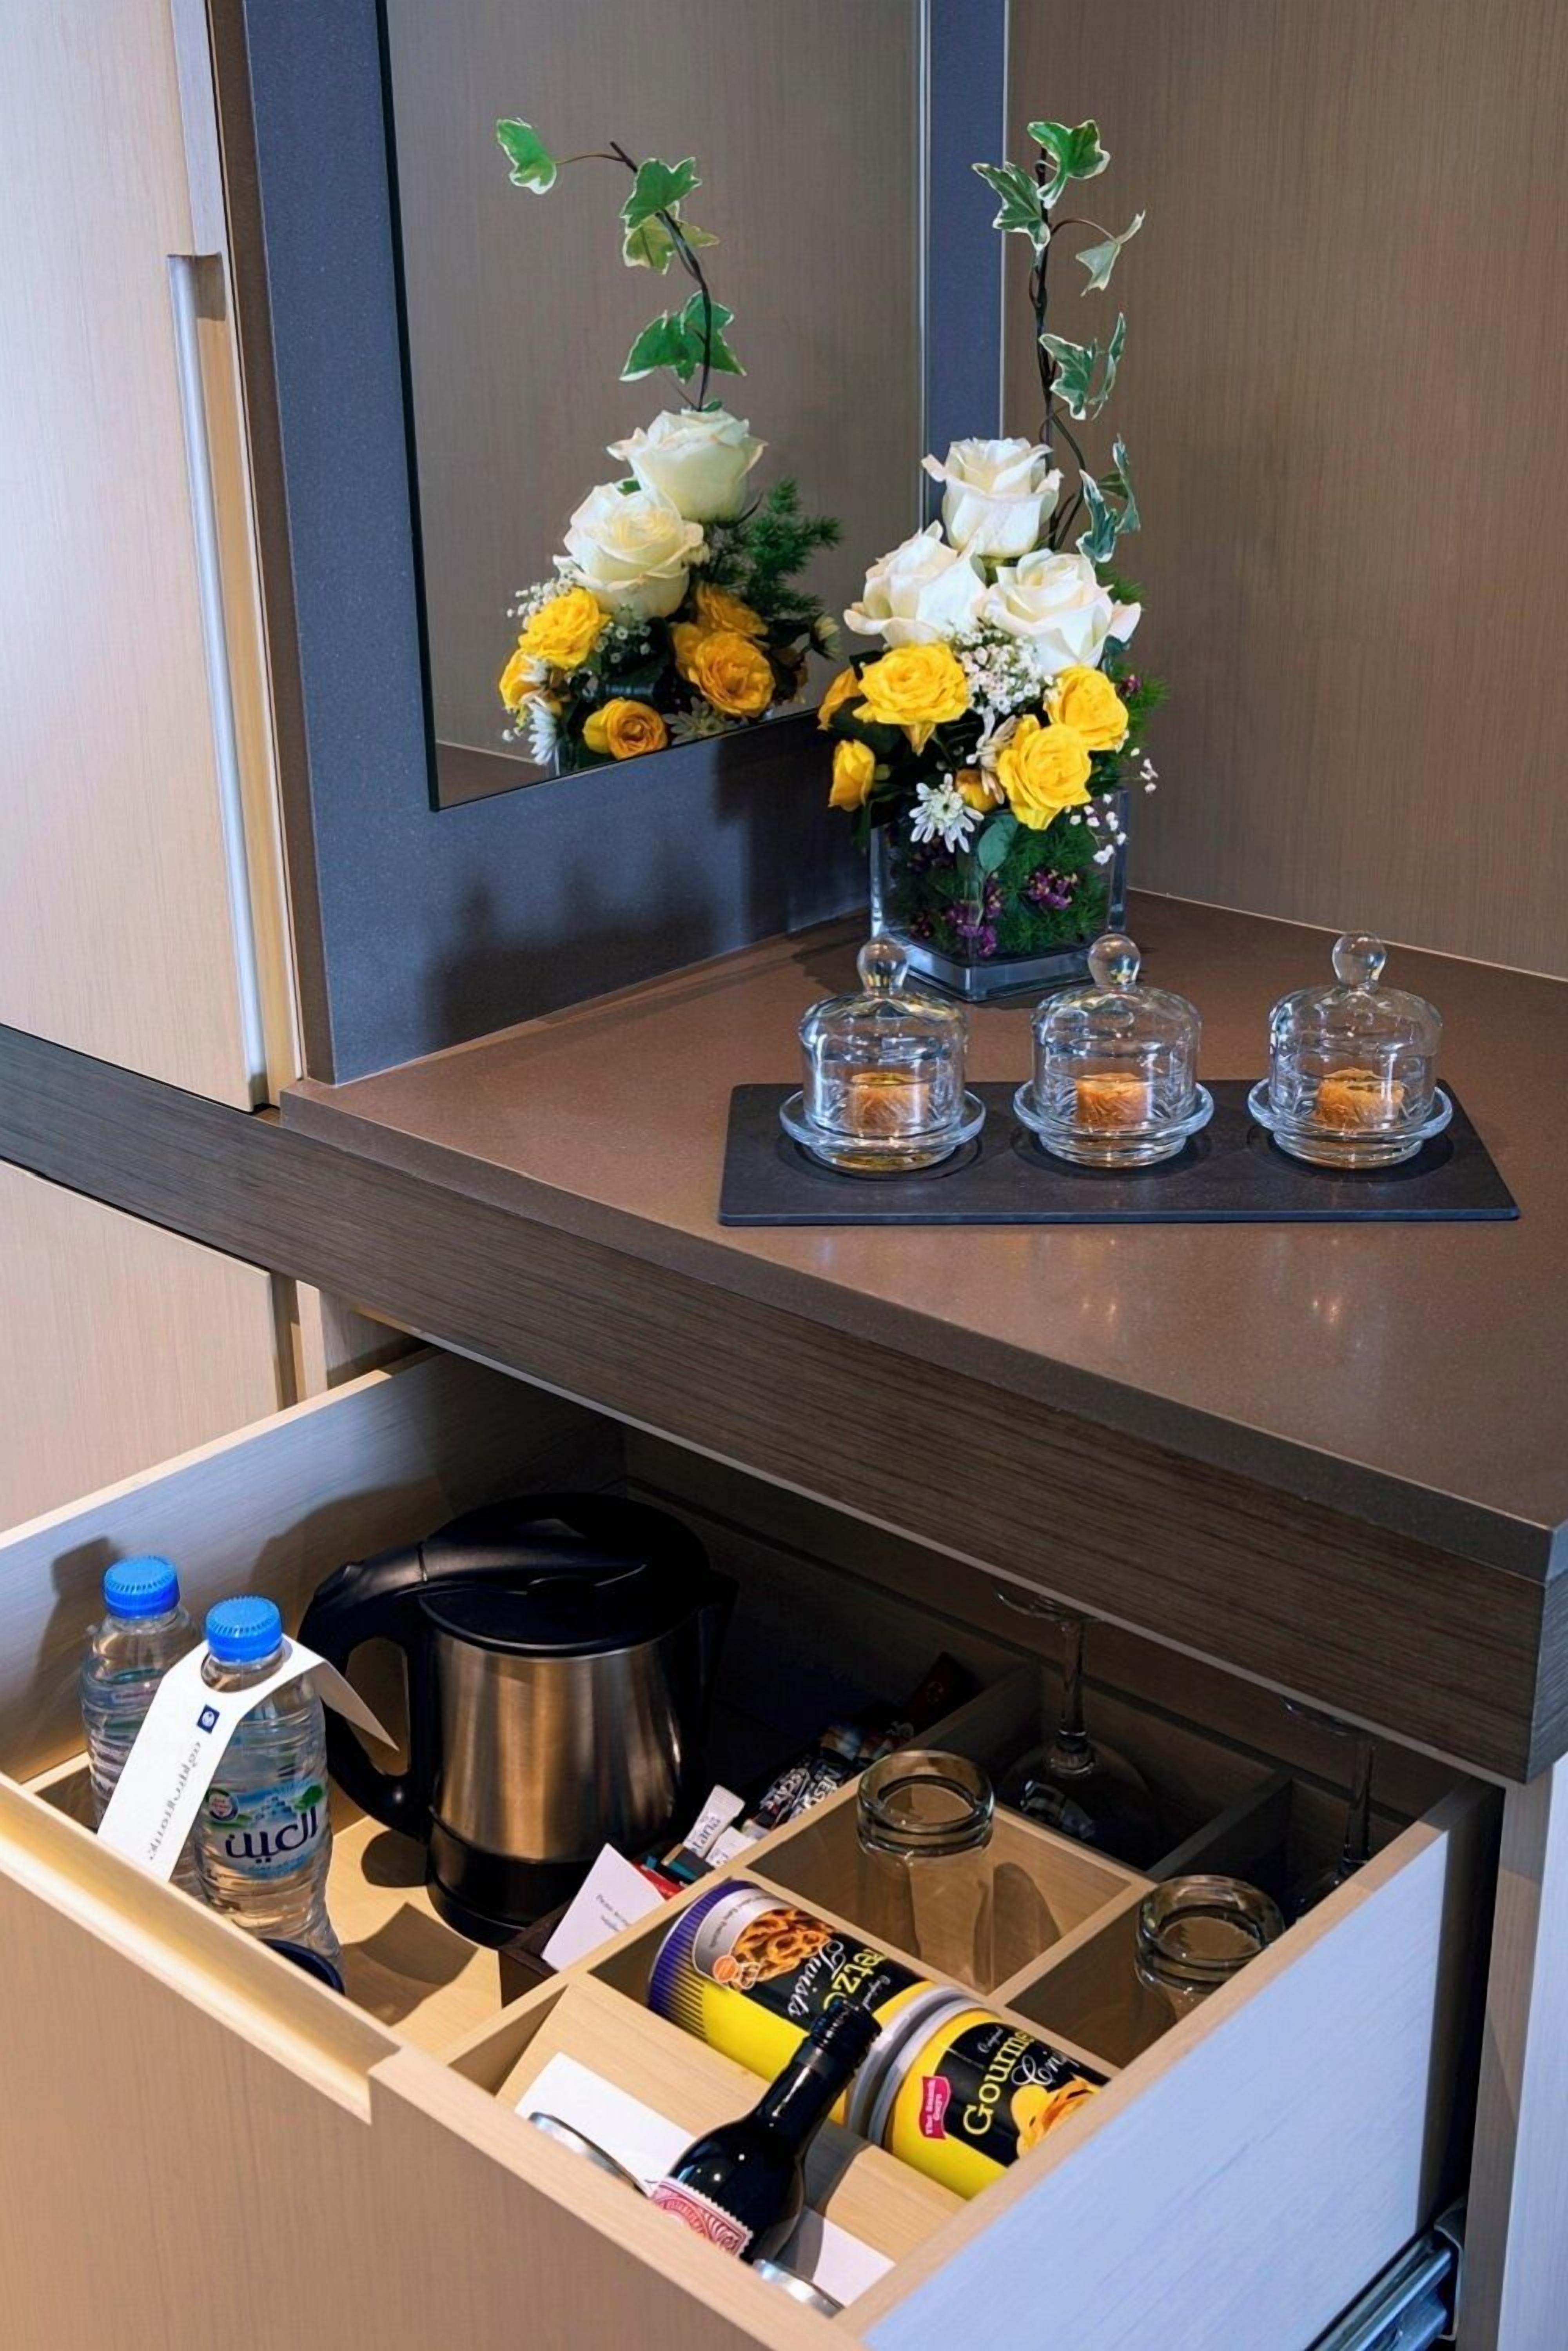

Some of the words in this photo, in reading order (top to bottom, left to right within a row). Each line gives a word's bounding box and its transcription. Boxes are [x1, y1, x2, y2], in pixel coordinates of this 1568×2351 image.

[225, 1806, 318, 1863] العين
[788, 1940, 847, 2017] Twists
[963, 2030, 1035, 2135] Gourme
